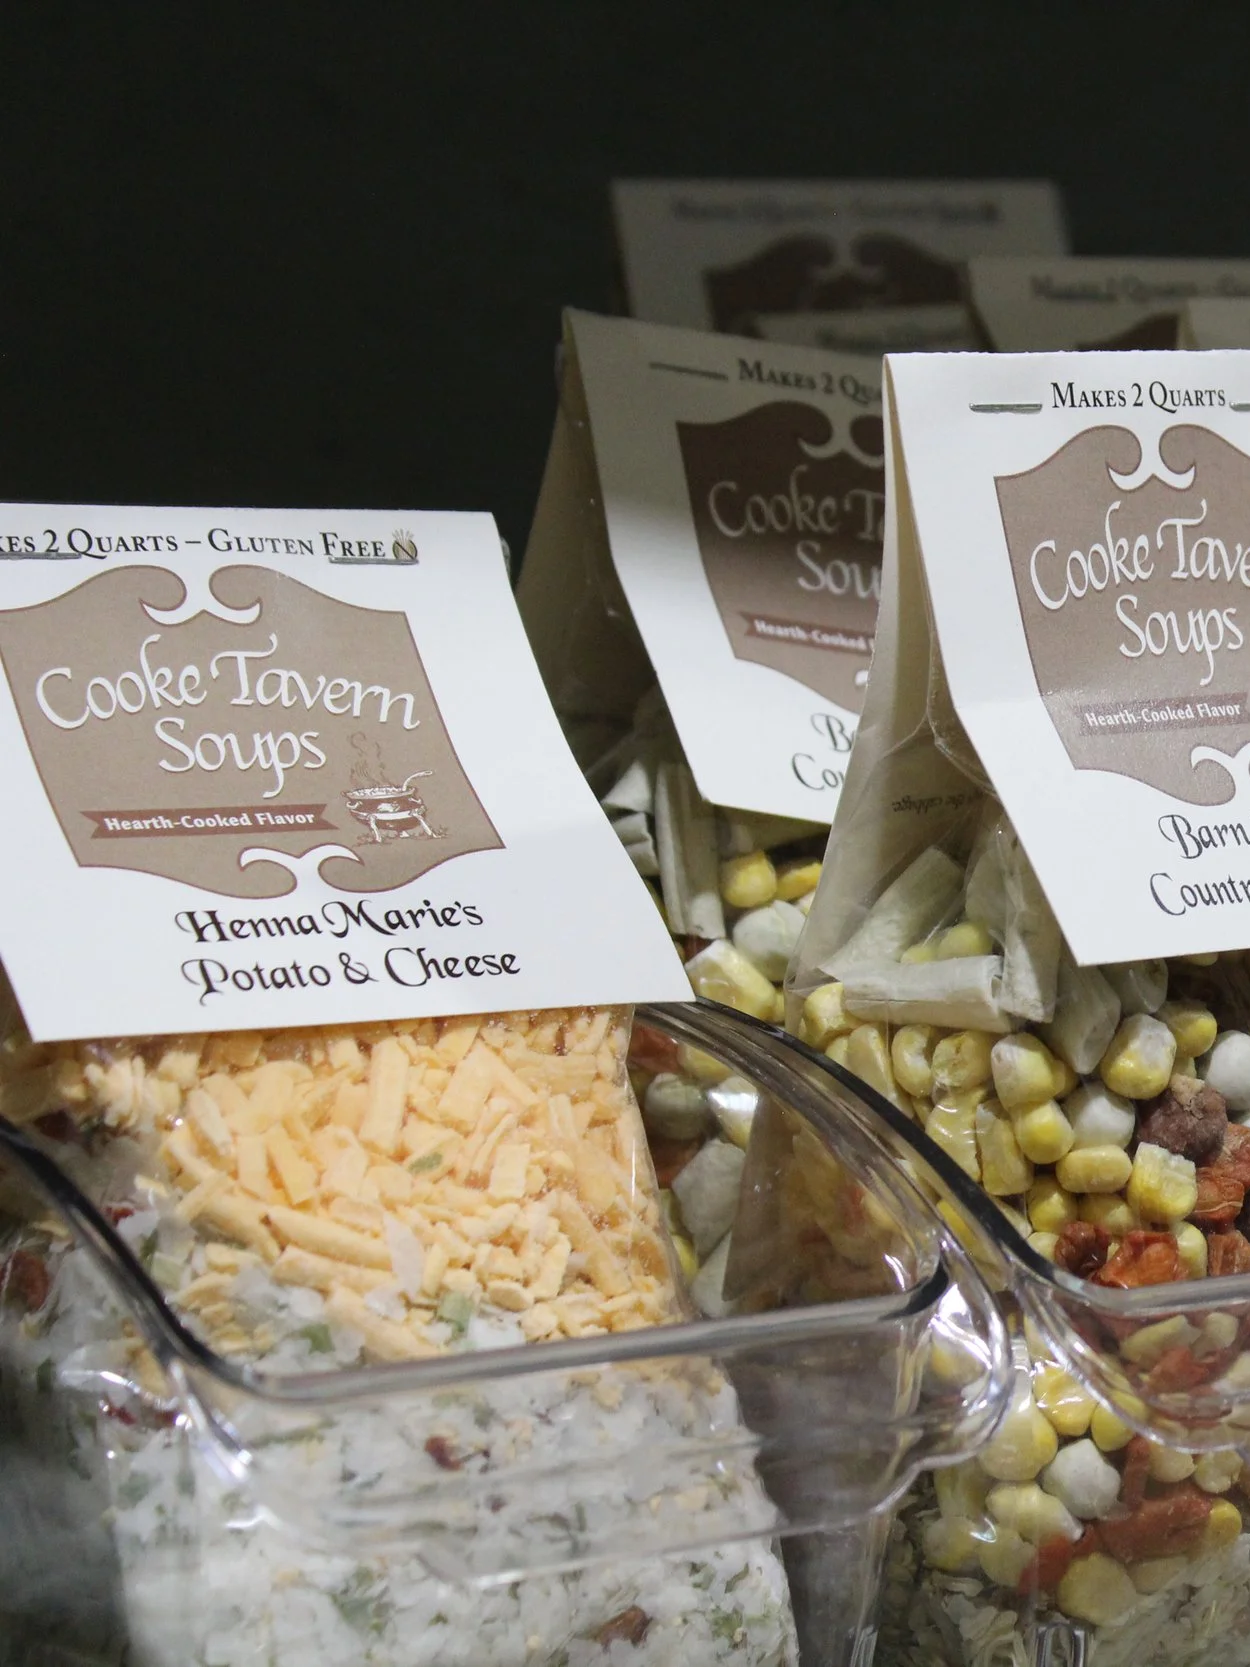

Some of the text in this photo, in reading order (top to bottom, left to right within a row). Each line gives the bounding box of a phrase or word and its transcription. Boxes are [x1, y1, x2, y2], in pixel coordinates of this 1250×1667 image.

[738, 358, 816, 391] MAKES
[821, 372, 834, 394] 2
[1050, 381, 1226, 414] MAKES 2 QUARTS
[709, 464, 840, 538] Cooke
[43, 529, 59, 553] 2
[67, 528, 179, 560] QUARTS
[207, 528, 314, 555] GLUTEN
[319, 531, 386, 557] FREE
[796, 539, 882, 600] Sou
[1030, 500, 1154, 610] Cooke
[1115, 594, 1244, 686] Soups
[36, 633, 421, 731] Cooke Tavern
[1085, 702, 1241, 727] Hearth-Cooked Flavor
[154, 717, 327, 799] Soups
[104, 811, 315, 831] Hearth-Cooked Flavor
[175, 900, 484, 943] Henna Marie's
[181, 947, 521, 1007] Potato & Cheese
